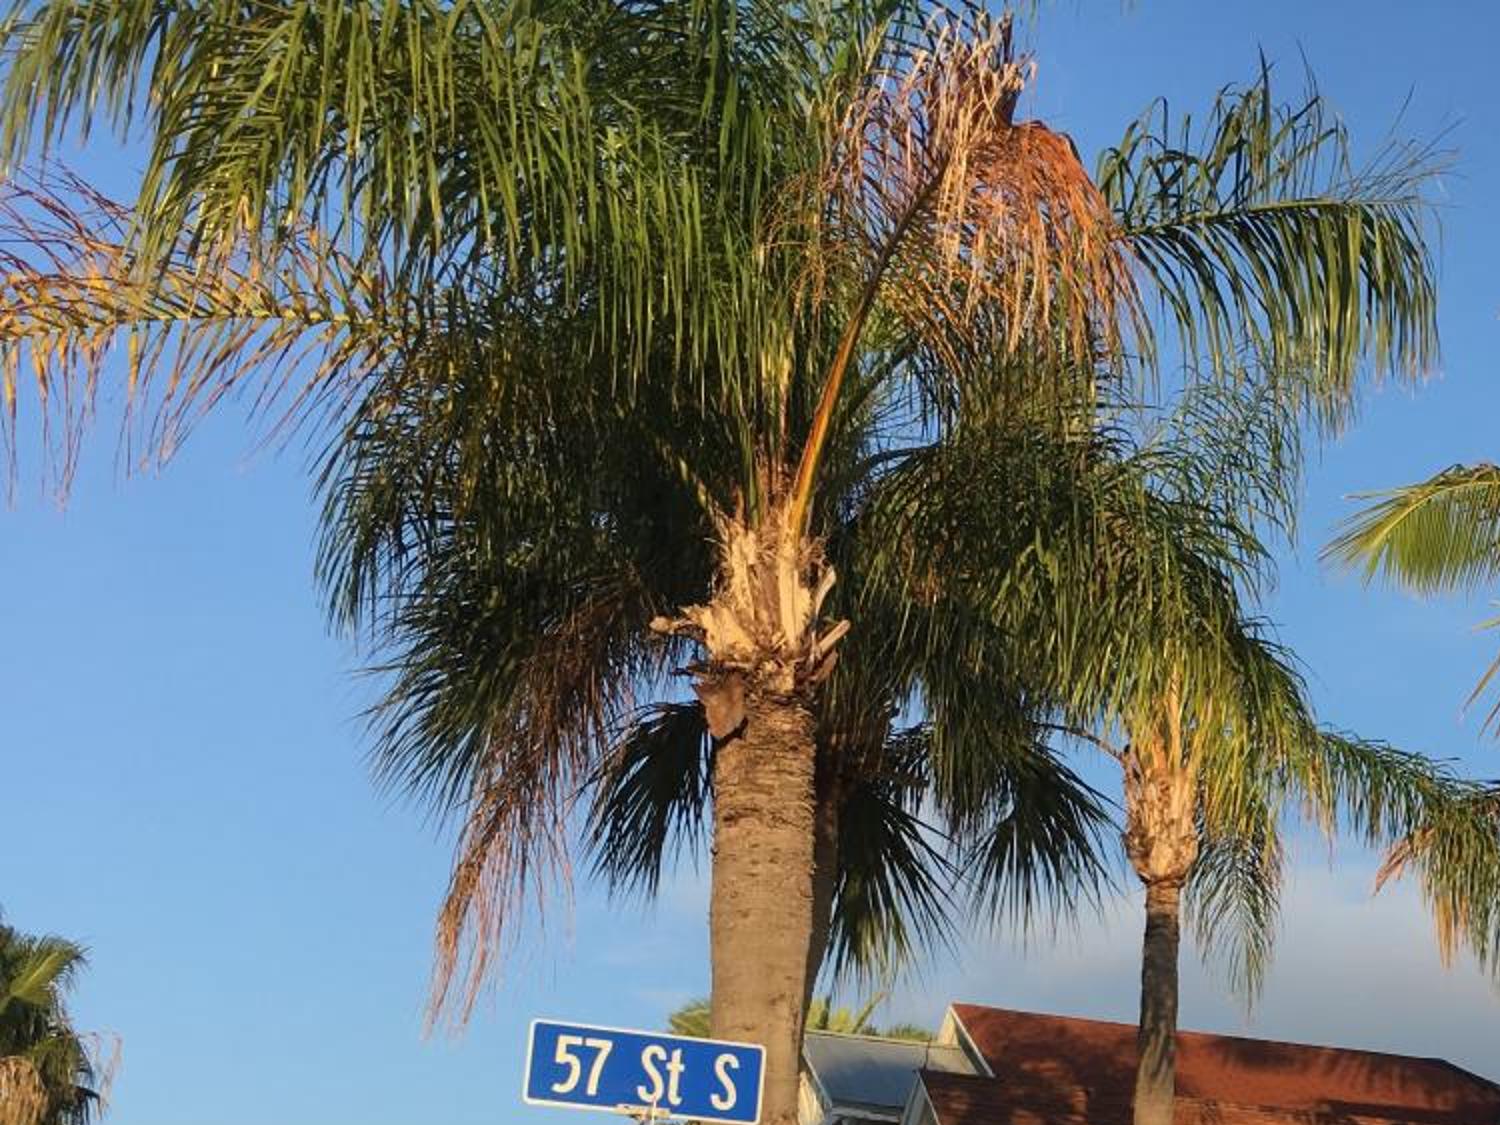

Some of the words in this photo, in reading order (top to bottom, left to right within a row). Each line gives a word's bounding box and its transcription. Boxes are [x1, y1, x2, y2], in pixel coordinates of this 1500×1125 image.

[551, 1034, 613, 1096] 57
[636, 1045, 685, 1106] St
[710, 1053, 740, 1111] S
